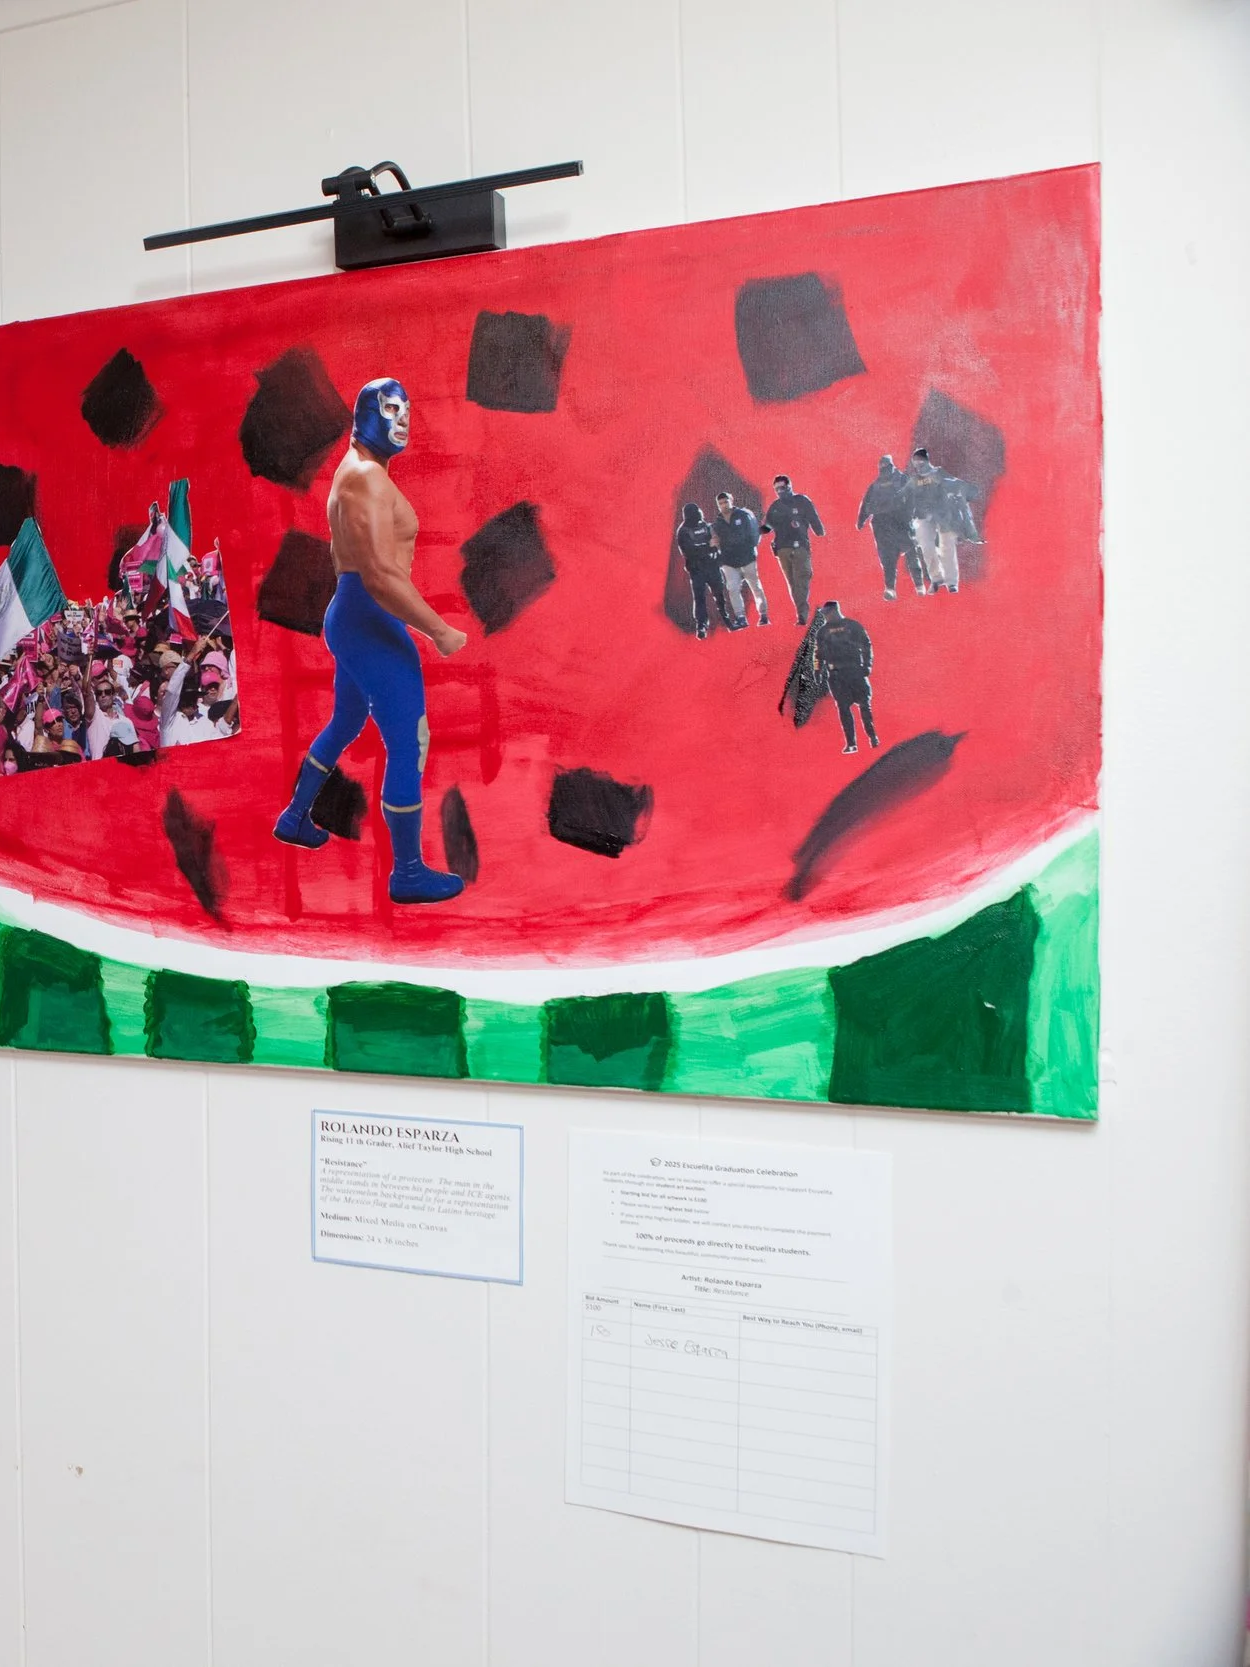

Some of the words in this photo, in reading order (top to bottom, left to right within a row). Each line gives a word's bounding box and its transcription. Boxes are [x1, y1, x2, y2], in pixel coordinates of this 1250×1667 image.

[321, 1120, 392, 1137] ROLANDO
[397, 1127, 459, 1143] ESPARZA
[320, 1135, 343, 1144] Rising
[366, 1139, 394, 1149] Grader,
[398, 1142, 416, 1150] Alief
[417, 1143, 442, 1152] Taylor
[445, 1145, 464, 1155] High
[466, 1147, 492, 1156] School
[664, 1160, 681, 1168] 2025
[682, 1161, 713, 1171] Escuelita
[715, 1164, 755, 1174] Graduation
[756, 1168, 798, 1177] Celebration
[320, 1176, 344, 1184] middle
[346, 1179, 369, 1187] stands
[381, 1181, 410, 1191] between
[411, 1183, 422, 1191] his
[424, 1187, 448, 1196] people
[450, 1188, 465, 1196] and
[467, 1190, 484, 1198] ICE
[329, 1169, 380, 1178] representation
[382, 1172, 391, 1182] of
[439, 1177, 451, 1186] The
[483, 1182, 495, 1190] the
[320, 1195, 329, 1203] of
[344, 1196, 371, 1205] Mexico
[372, 1199, 387, 1208] flag
[389, 1201, 404, 1209] and
[438, 1205, 462, 1215] Latino
[321, 1184, 334, 1192] The
[336, 1188, 378, 1196] watermelon
[380, 1190, 423, 1201] background
[433, 1196, 444, 1205] for
[453, 1199, 509, 1210] representation
[320, 1211, 352, 1222] Medium:
[355, 1216, 379, 1225] Mixed
[381, 1218, 405, 1228] Media
[419, 1222, 448, 1232] Canvas
[320, 1229, 364, 1241] Dimensions:
[367, 1234, 375, 1242] 24
[385, 1236, 393, 1245] 36
[394, 1240, 419, 1248] inches
[635, 1232, 653, 1240] 100%
[664, 1237, 695, 1245] proceeds
[707, 1240, 733, 1249] directly
[744, 1243, 776, 1253] Escuelita
[778, 1247, 811, 1256] students.
[681, 1274, 702, 1282] Artist:
[704, 1277, 733, 1285] Rolando
[735, 1280, 762, 1289] Esparza
[694, 1285, 711, 1293] Title:
[713, 1287, 749, 1297] Resistance
[585, 1303, 602, 1311] $100
[596, 1296, 619, 1304] Amount
[634, 1301, 651, 1309] Name
[670, 1305, 686, 1313] Last)
[757, 1316, 771, 1324] Way
[815, 1323, 840, 1332] (Phone,
[841, 1327, 862, 1335] email)
